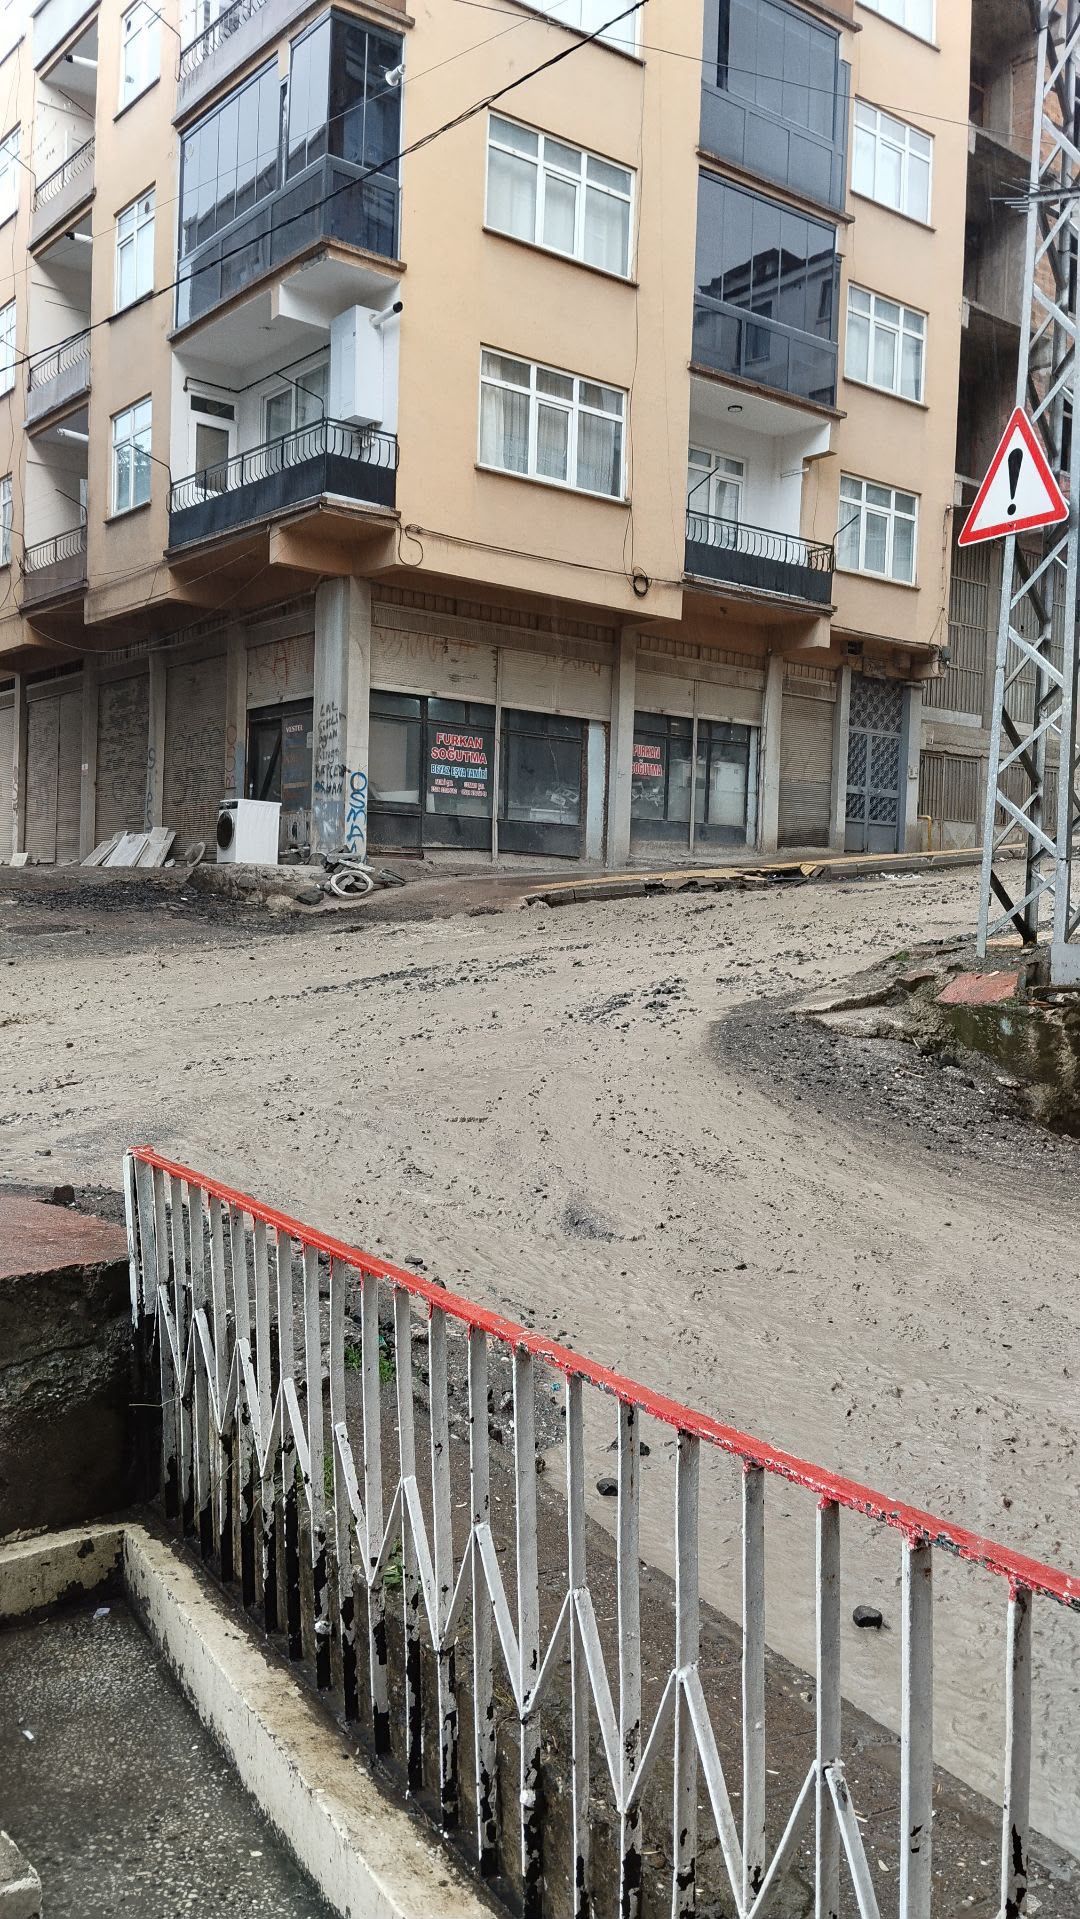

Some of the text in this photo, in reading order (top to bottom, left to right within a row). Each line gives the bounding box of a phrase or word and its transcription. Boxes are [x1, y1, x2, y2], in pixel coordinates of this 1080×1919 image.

[286, 724, 304, 733] VESTEL
[436, 732, 483, 749] FURKAN
[431, 746, 488, 765] SOĞUTMA
[633, 743, 661, 759] FURKAN
[431, 764, 450, 775] BEYAZ
[451, 766, 466, 778] EŞYA
